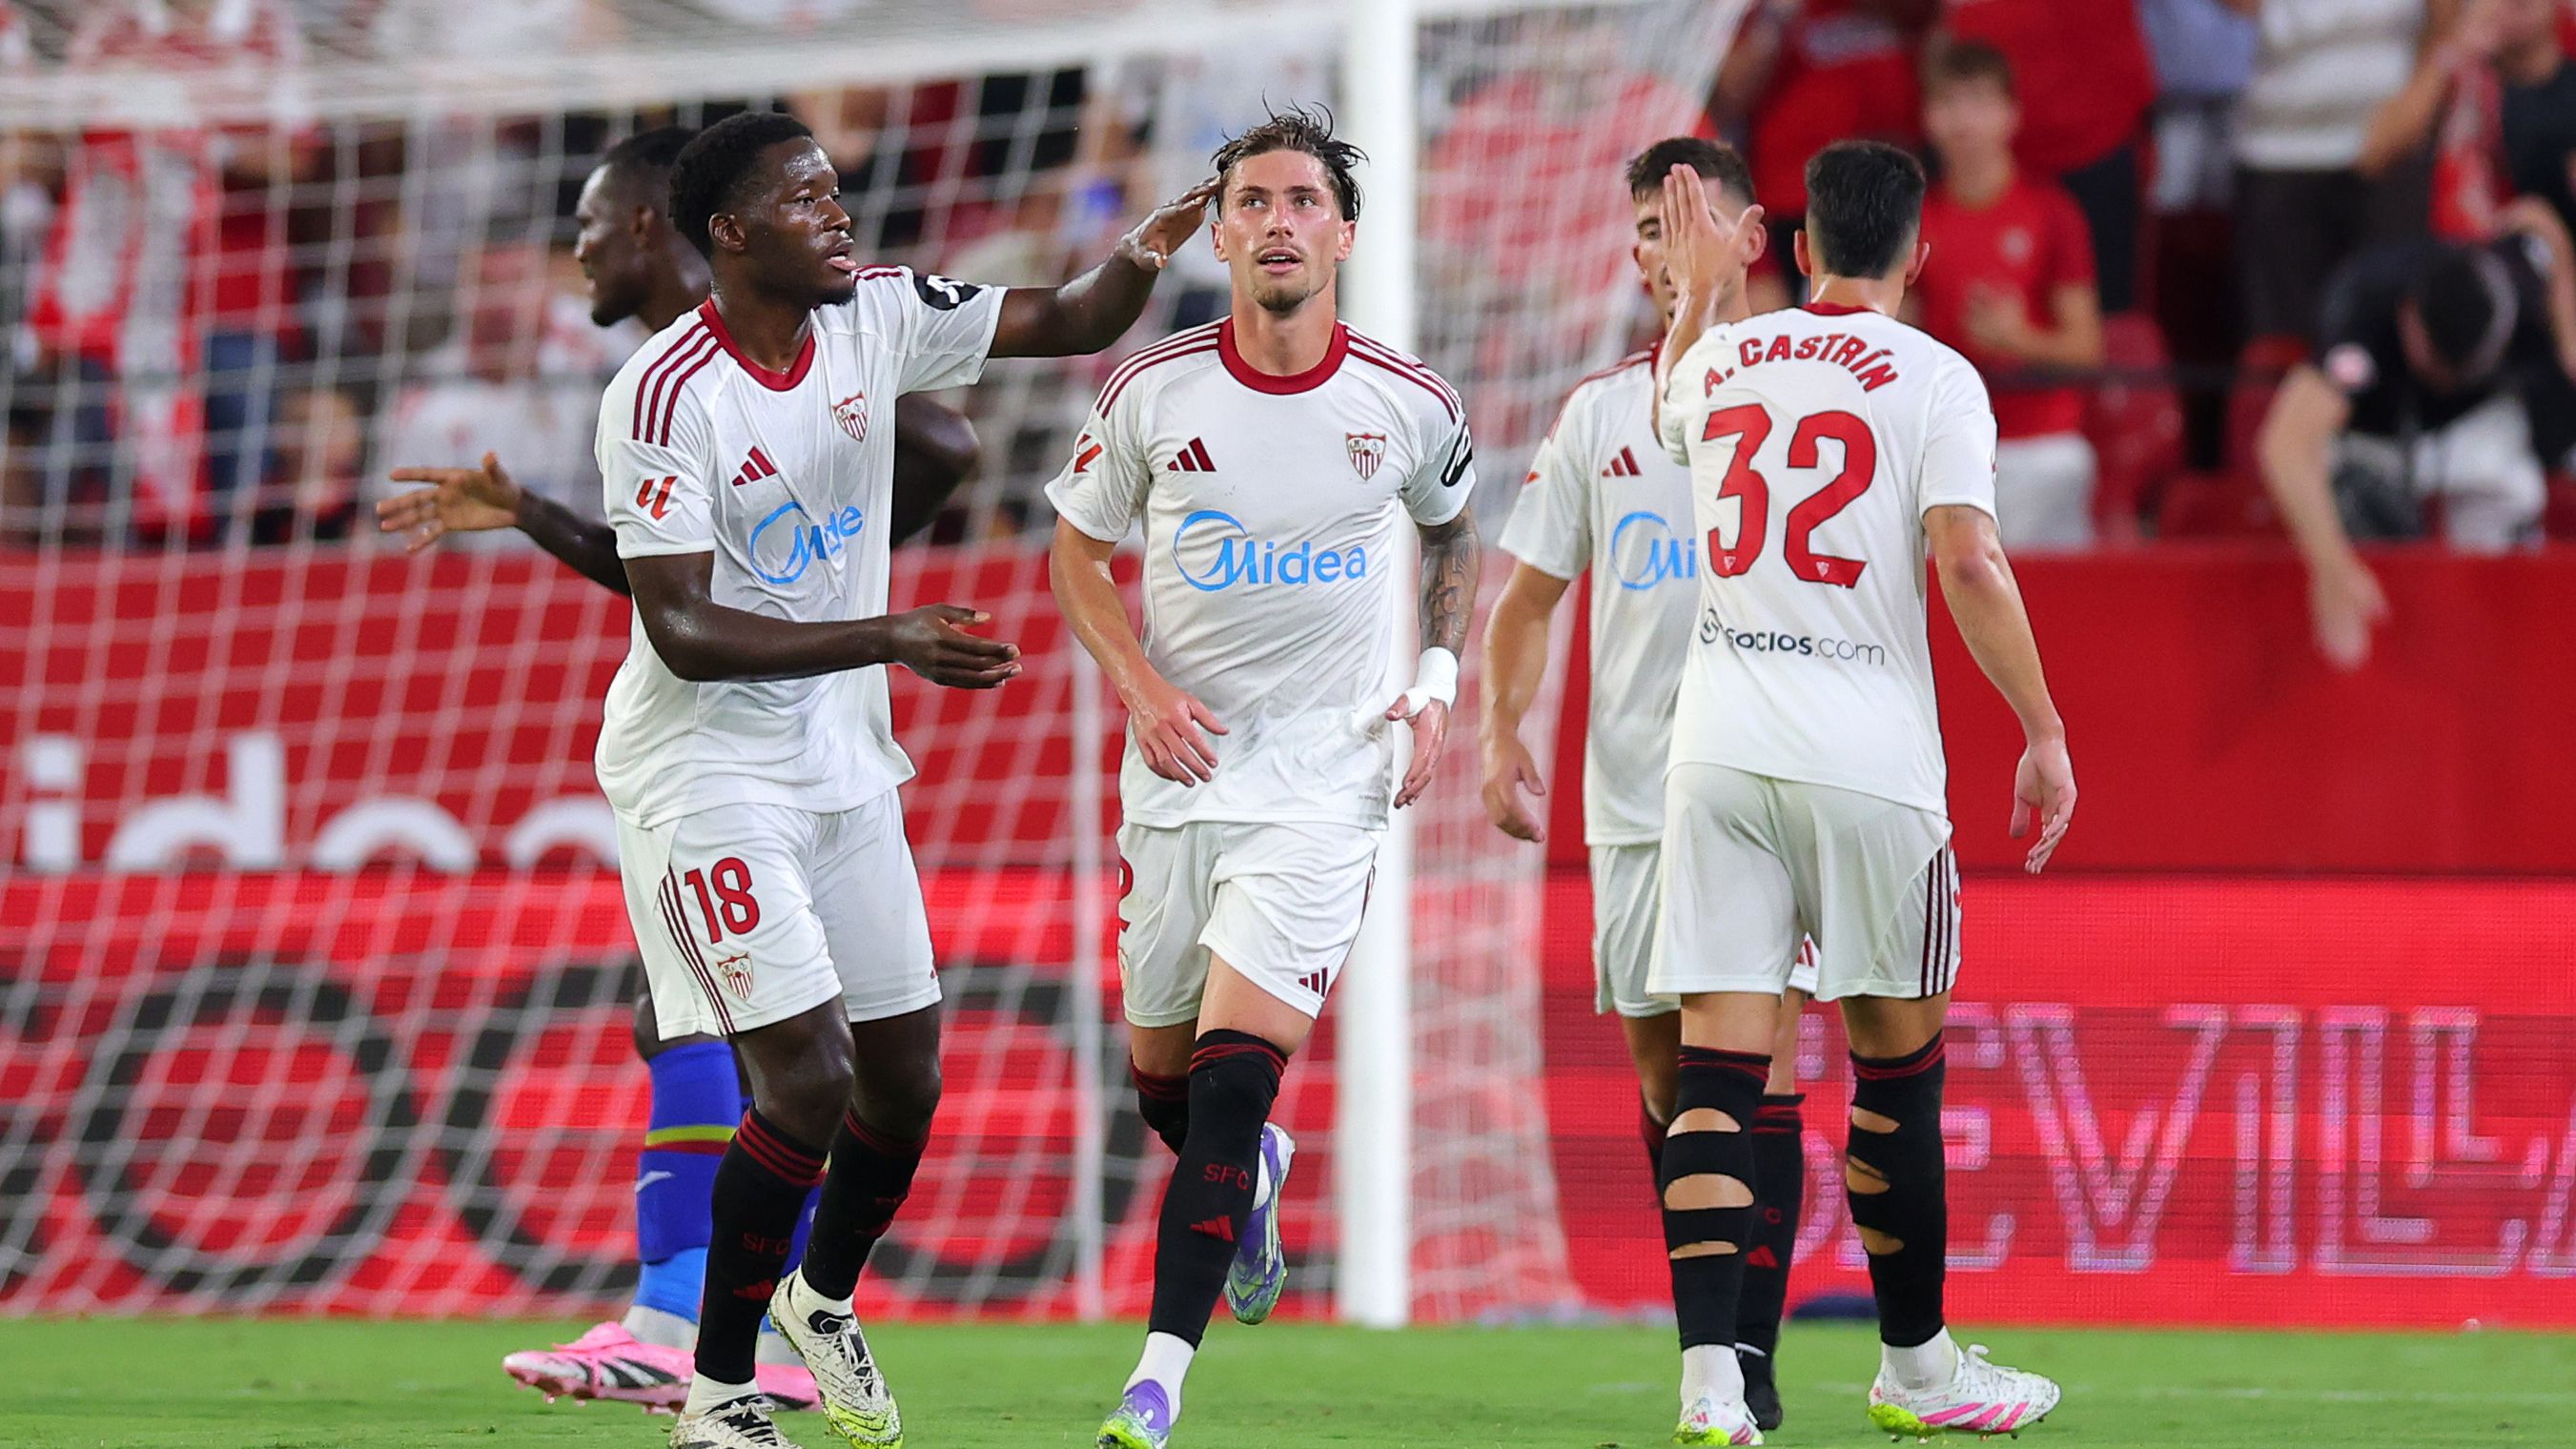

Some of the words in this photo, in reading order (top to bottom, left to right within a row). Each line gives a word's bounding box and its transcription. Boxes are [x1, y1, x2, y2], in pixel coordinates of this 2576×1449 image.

[1705, 366, 1735, 398] A.
[1739, 334, 1899, 393] CASTRÍN
[1702, 402, 1876, 589] 32
[1172, 509, 1367, 591] Midea
[1611, 510, 1696, 591] Mi
[685, 856, 760, 945] 18
[1792, 1001, 2576, 1276] EVILL
